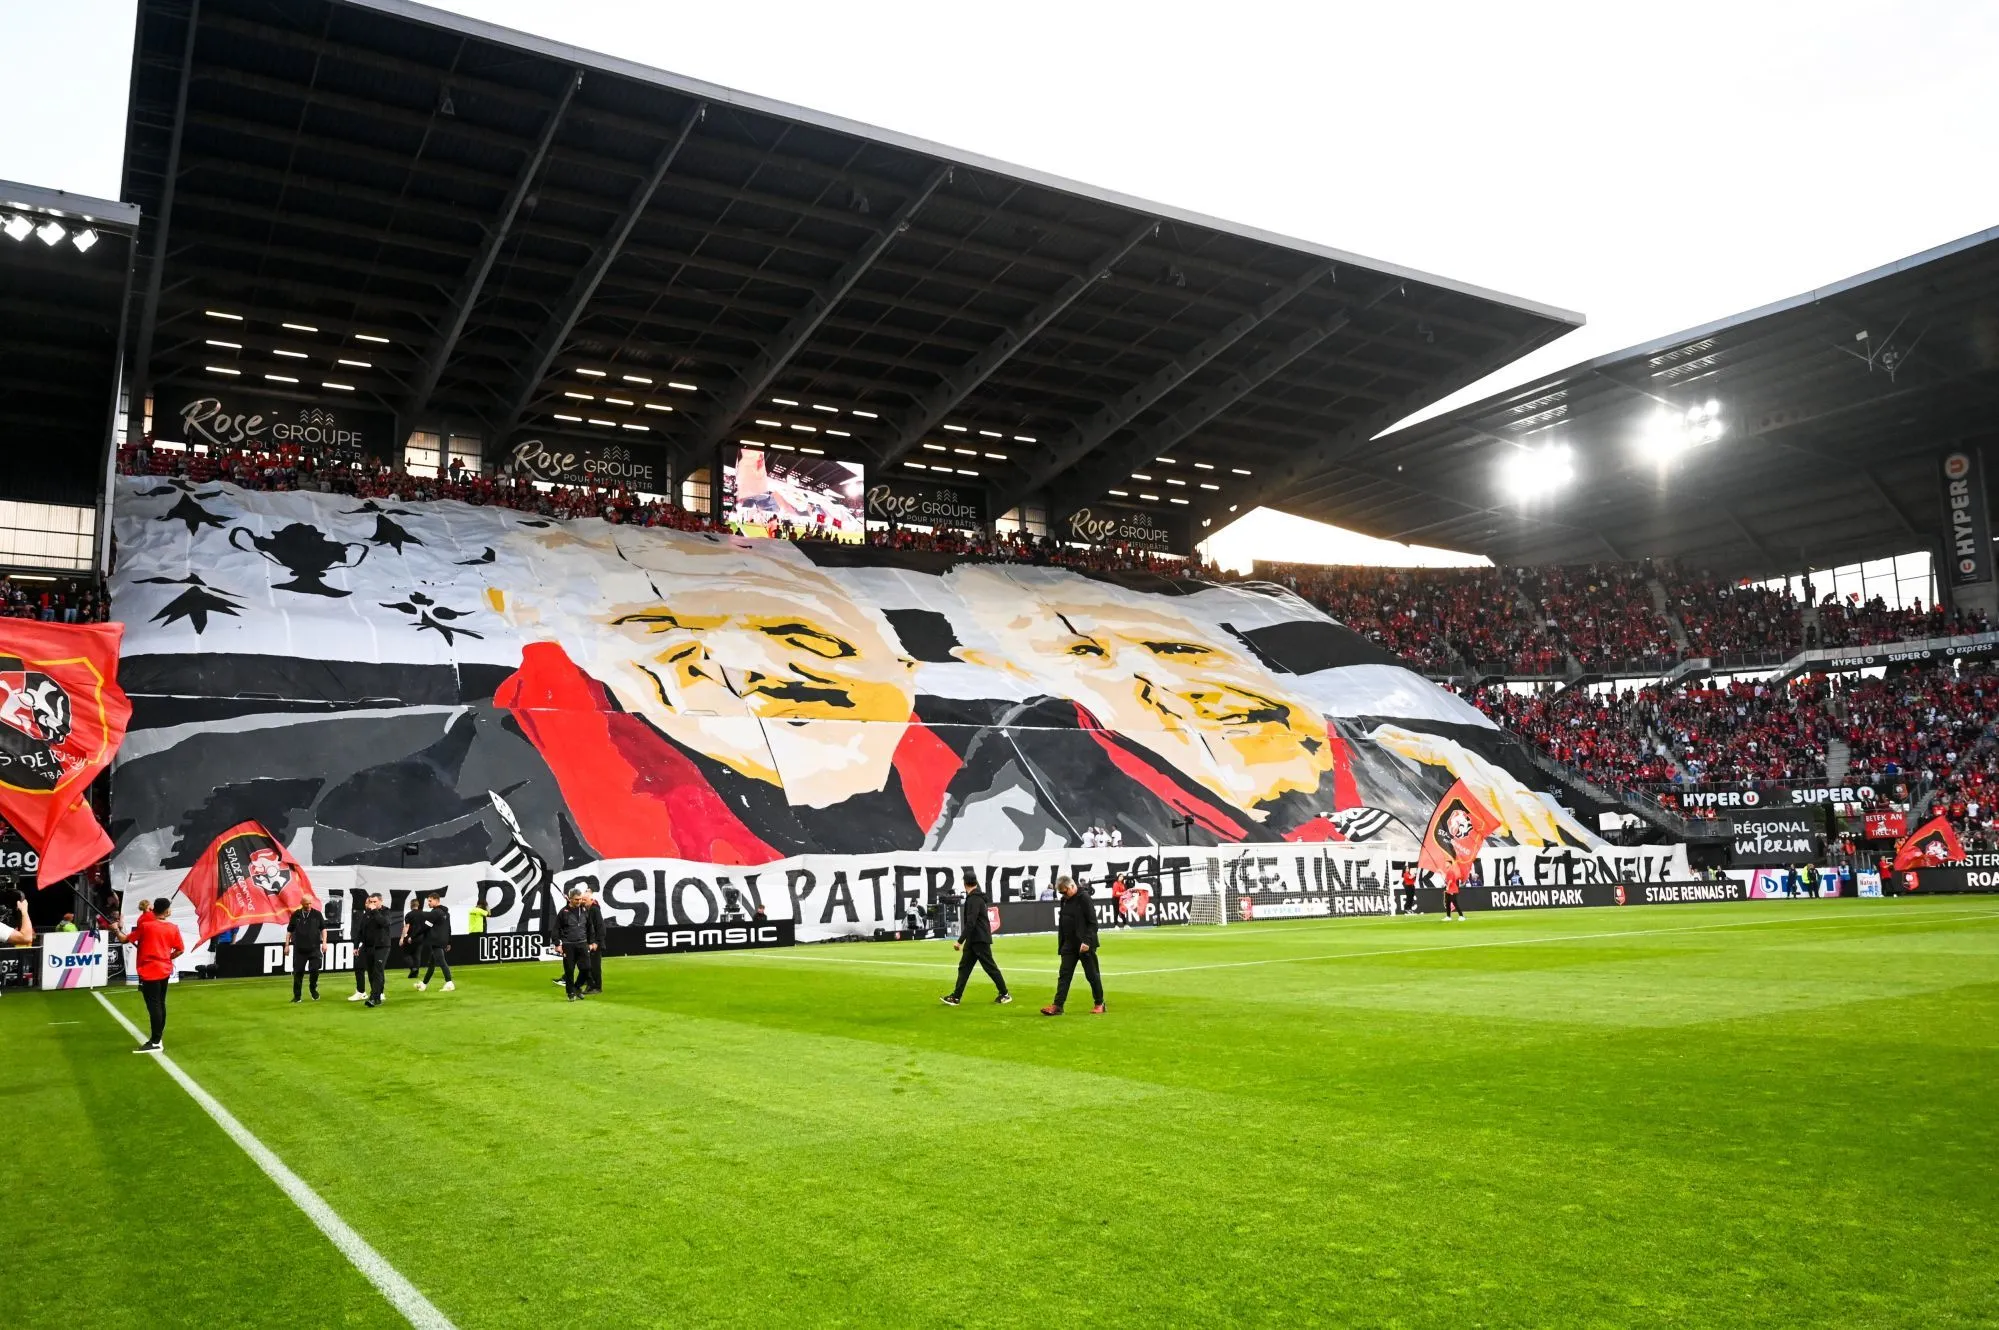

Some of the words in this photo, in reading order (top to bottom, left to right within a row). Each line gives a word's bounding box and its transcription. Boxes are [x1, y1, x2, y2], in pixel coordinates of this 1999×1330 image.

[179, 397, 268, 445] Rose
[272, 423, 362, 449] GROUPE
[512, 440, 580, 481] Rose
[583, 459, 653, 480] GROUPE
[866, 485, 919, 518] Rose
[921, 502, 977, 519] GROUPE
[1069, 508, 1119, 542] Rose
[1119, 525, 1168, 543] GROUPE
[1949, 478, 1976, 556] HYPER
[1888, 652, 1921, 662] SUPER
[1957, 643, 1993, 655] express
[1831, 658, 1863, 667] HYPER
[1683, 792, 1741, 807] HYPER
[1791, 787, 1854, 804] SUPER
[1890, 813, 1903, 821] AN
[1733, 821, 1810, 834] RÉGIONAL
[225, 847, 243, 874] STADE
[1491, 890, 1549, 907] ROAZHON
[1551, 889, 1584, 905] PARK
[1645, 887, 1679, 902] STADE
[1681, 885, 1725, 900] RENNAIS
[1726, 884, 1739, 898] FC
[1145, 901, 1191, 921] PARK
[645, 926, 778, 948] SAMSIC
[65, 954, 102, 967] BWT
